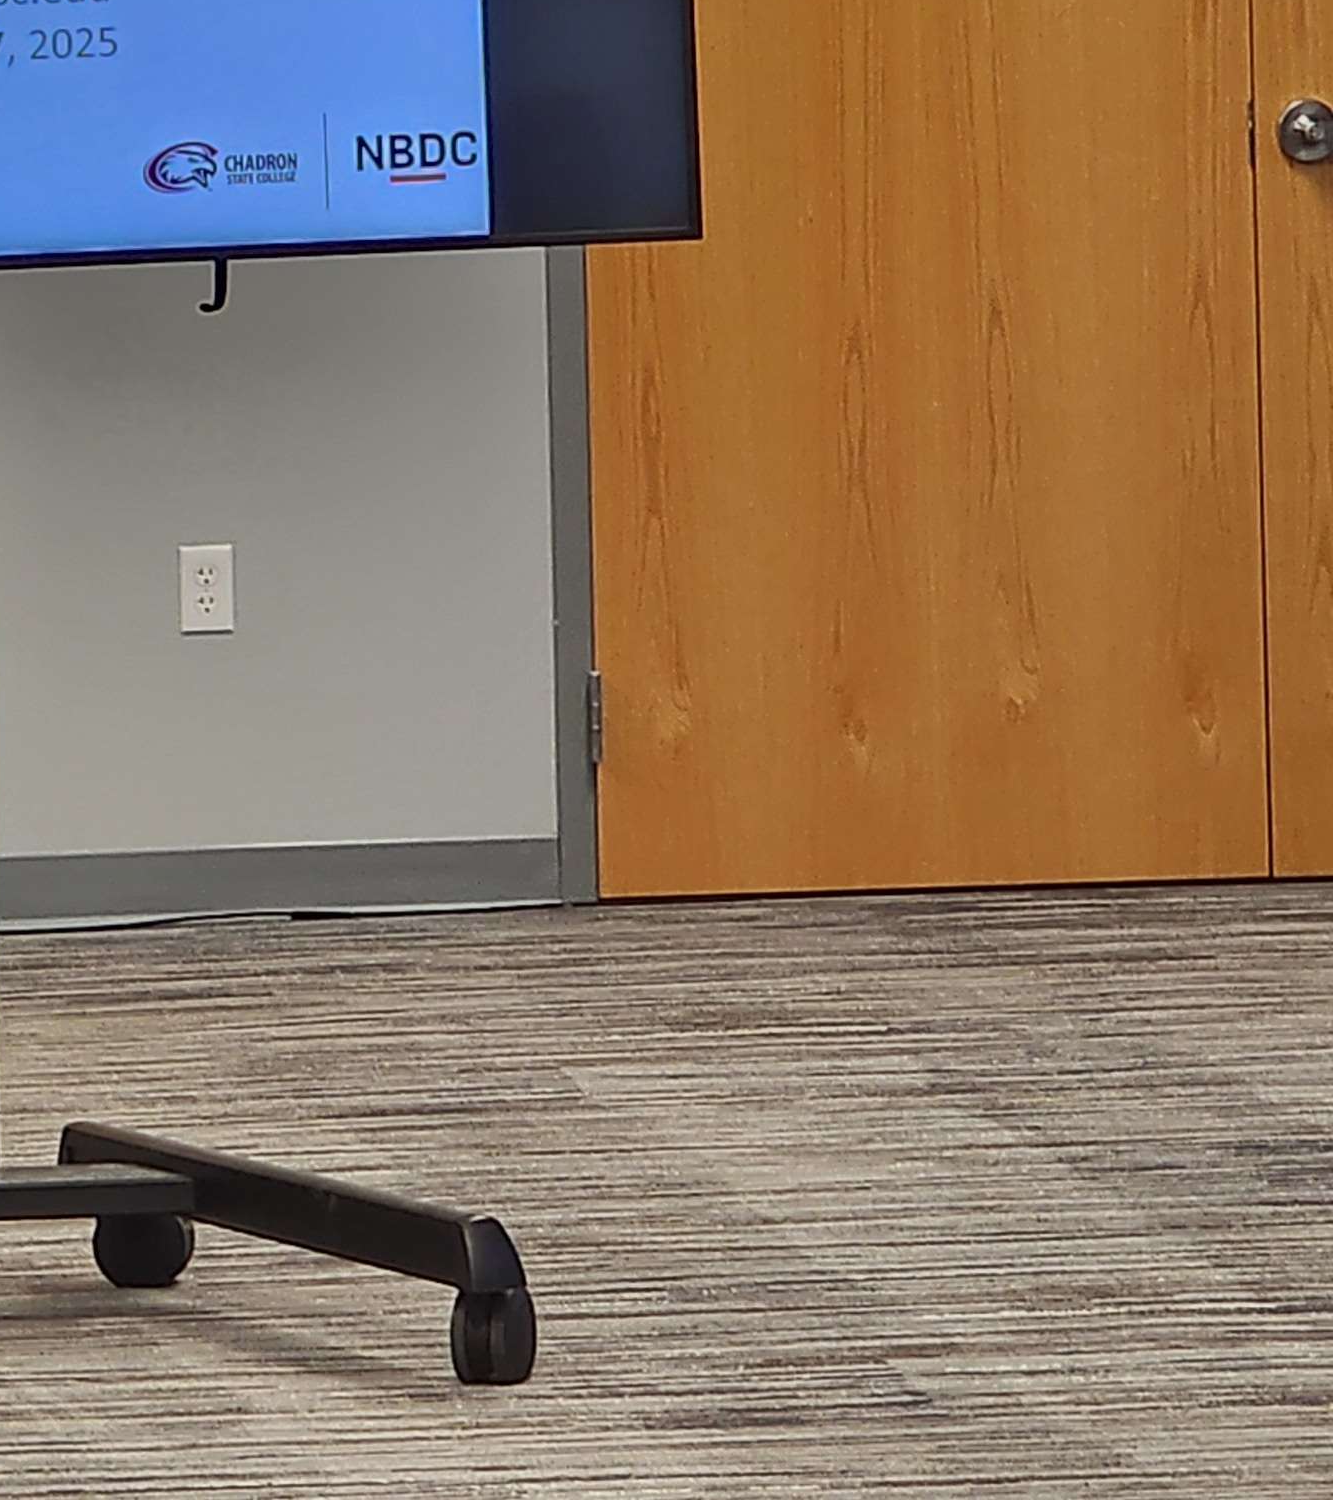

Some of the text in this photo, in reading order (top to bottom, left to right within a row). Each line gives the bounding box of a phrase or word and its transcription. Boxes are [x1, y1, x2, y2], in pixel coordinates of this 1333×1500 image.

[30, 26, 119, 60] 2025
[223, 152, 298, 172] CHADRON
[355, 130, 478, 172] NBDC
